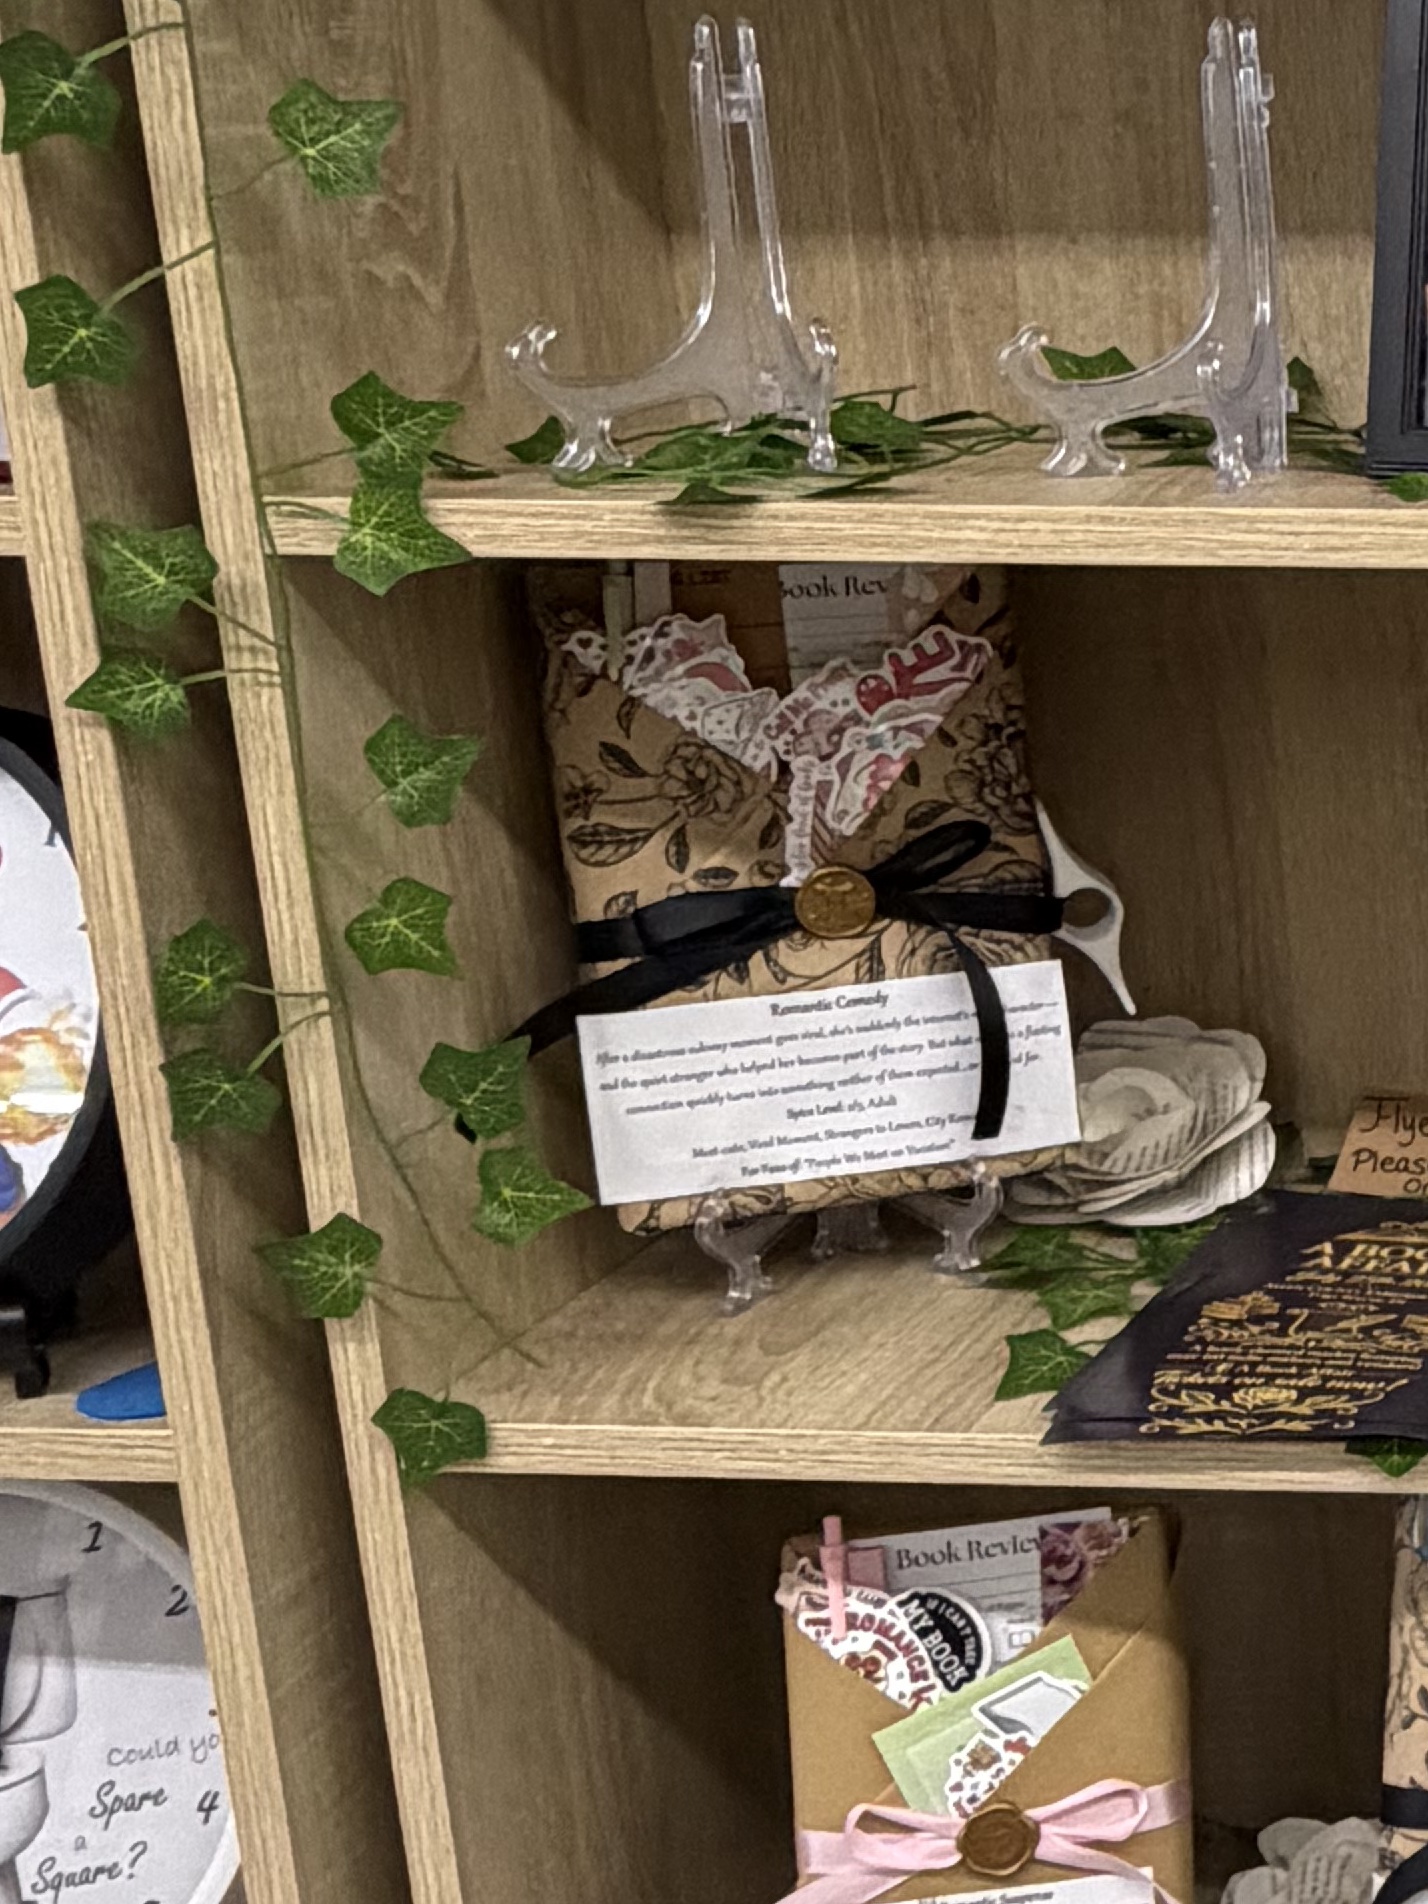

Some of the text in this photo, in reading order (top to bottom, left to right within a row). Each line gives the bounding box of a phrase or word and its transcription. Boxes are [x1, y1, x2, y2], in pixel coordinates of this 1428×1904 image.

[1301, 1242, 1333, 1255] A
[80, 1520, 105, 1552] 1
[164, 1584, 190, 1617] 2
[106, 1730, 222, 1769] could yo
[89, 1779, 169, 1828] Spare
[197, 1790, 219, 1822] 4
[74, 1834, 88, 1852] a
[31, 1842, 147, 1900] Square?
